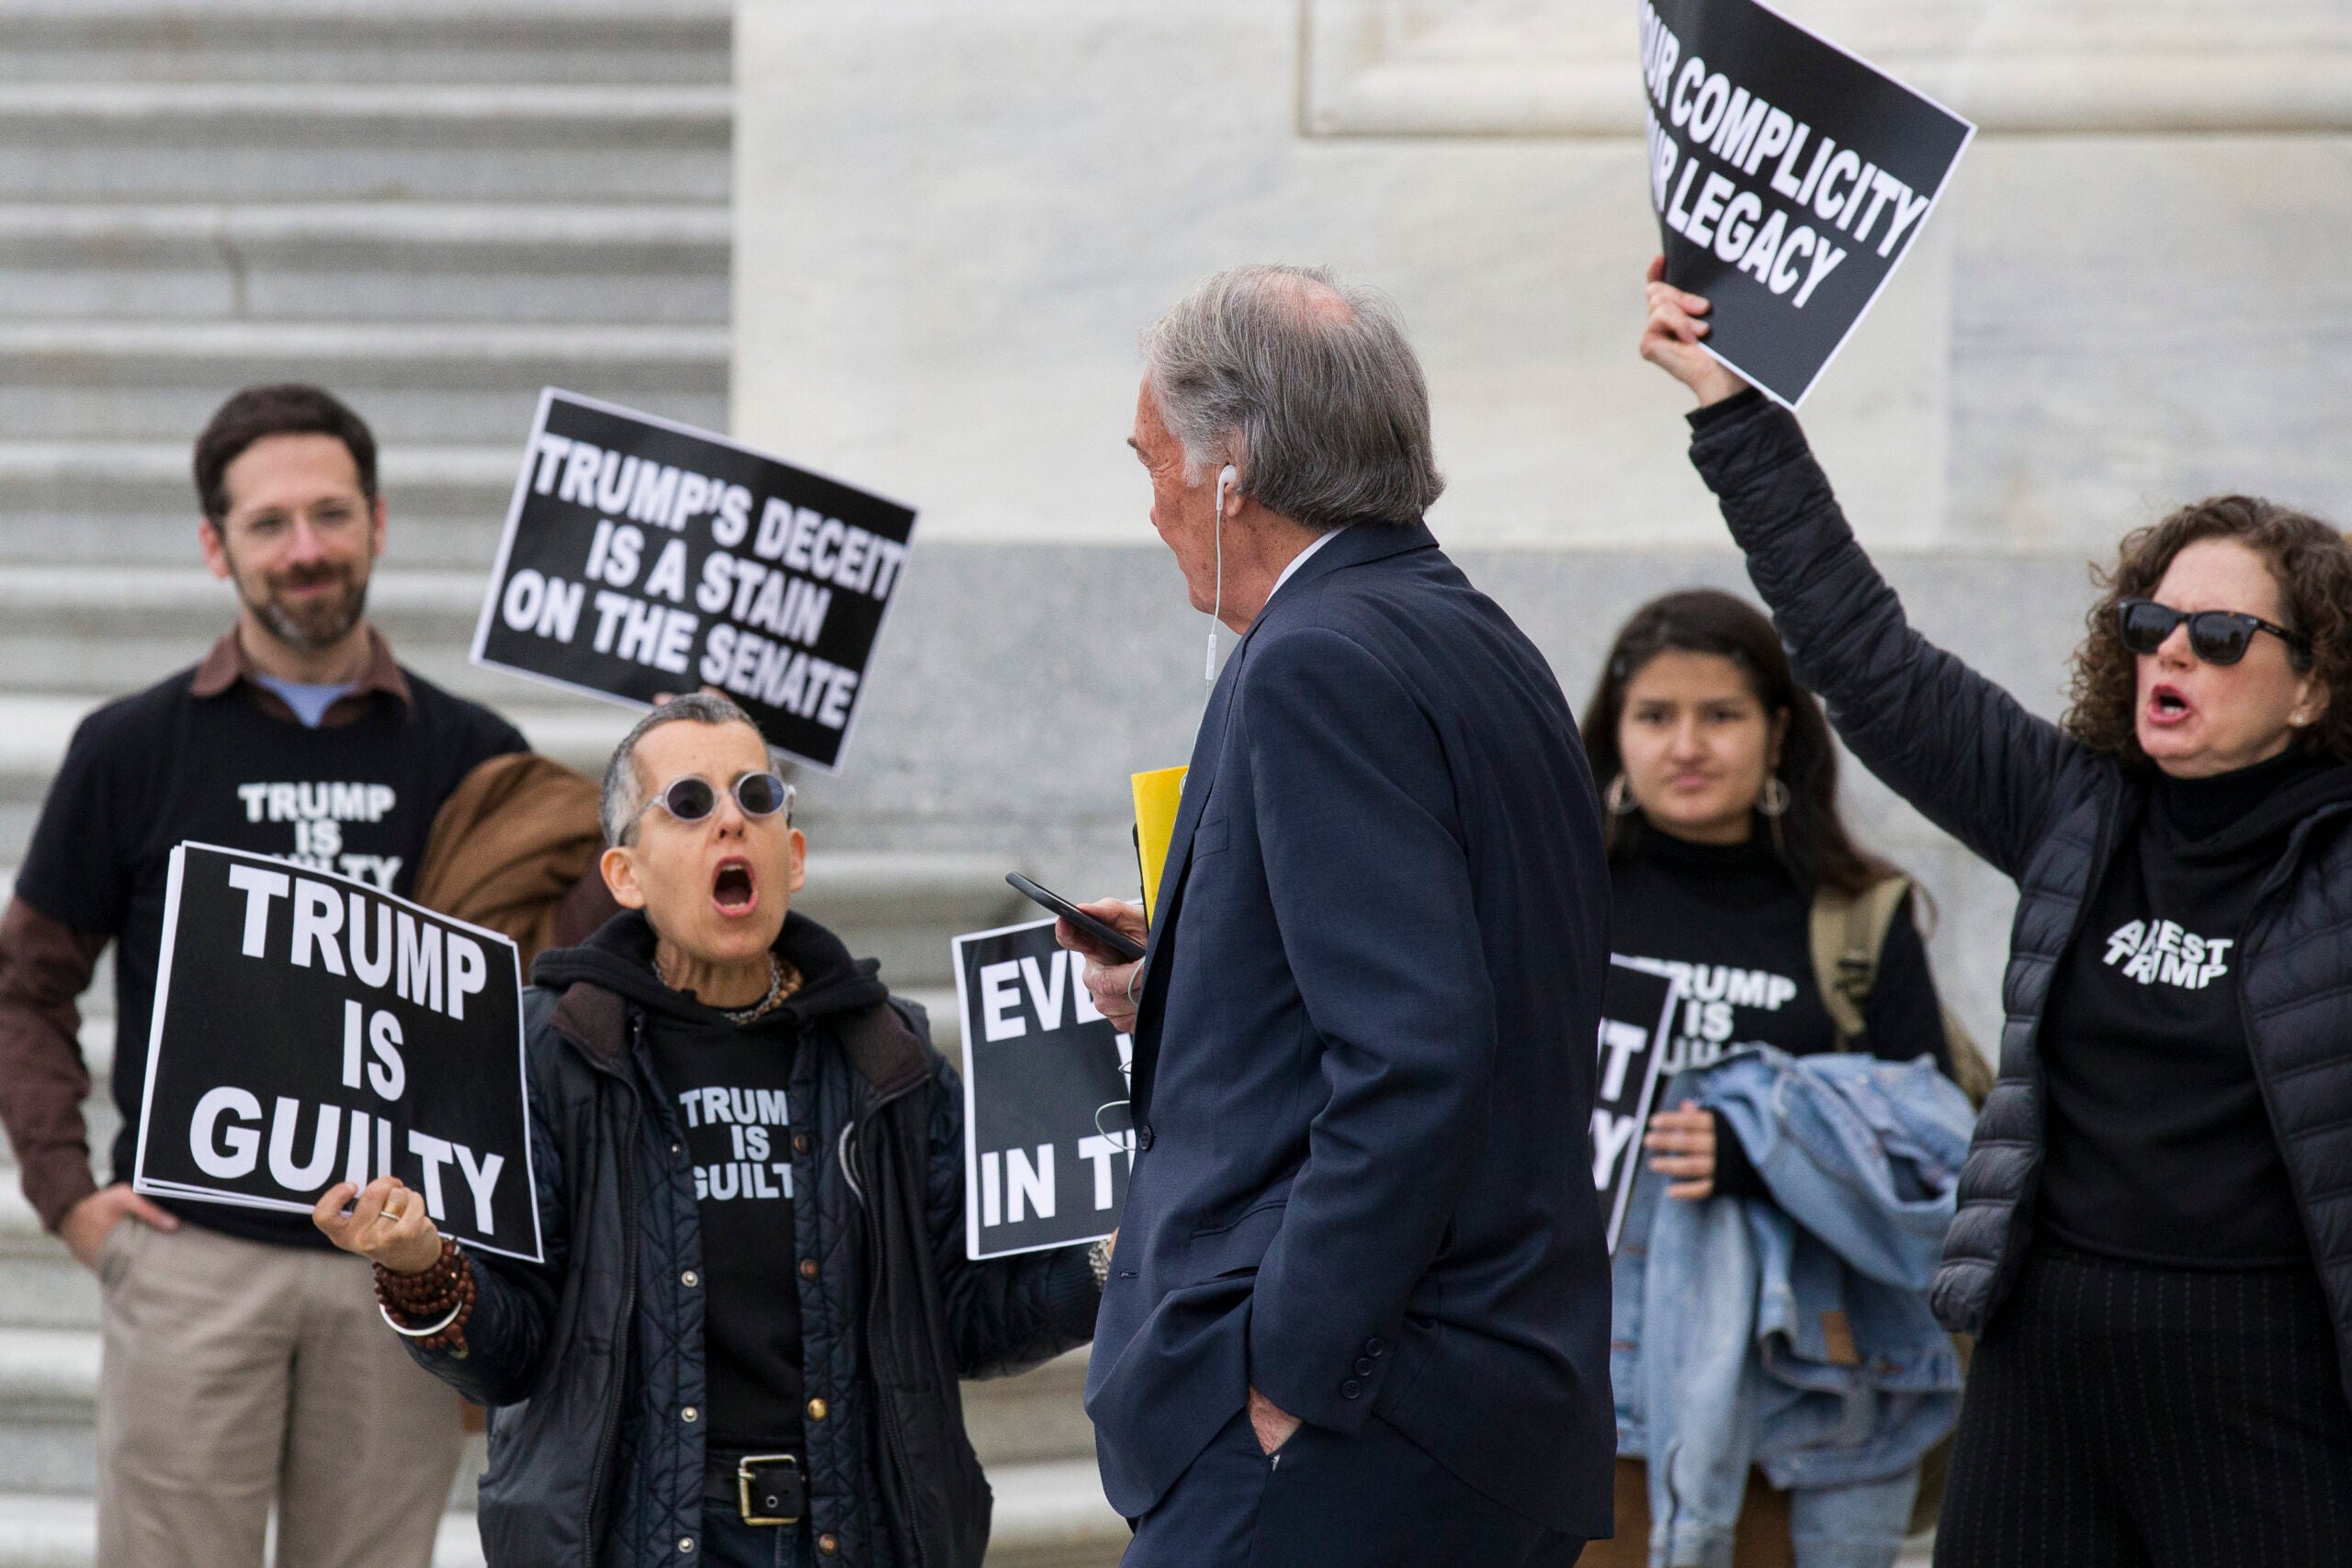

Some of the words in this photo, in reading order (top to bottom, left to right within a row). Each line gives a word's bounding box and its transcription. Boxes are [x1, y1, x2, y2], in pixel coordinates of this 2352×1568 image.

[1669, 56, 1930, 258] COMPLICITY
[1665, 156, 1848, 310] LEGACY
[534, 433, 753, 547] TRUMP'S
[752, 496, 908, 602] DECEIT
[584, 518, 646, 589] IS
[644, 537, 688, 604] A
[695, 550, 833, 646] STAIN
[502, 568, 585, 644] ON
[592, 589, 700, 675] THE
[698, 623, 860, 731] SENATE
[236, 781, 397, 823] TRUMP
[294, 818, 344, 859] IS
[228, 863, 488, 1021] TRUMP
[342, 998, 407, 1102] IS
[1683, 999, 1735, 1043] IS
[678, 1086, 790, 1129] TRUM
[730, 1123, 771, 1162] IS
[693, 1161, 796, 1201] GUILT
[980, 1142, 1057, 1228] IN
